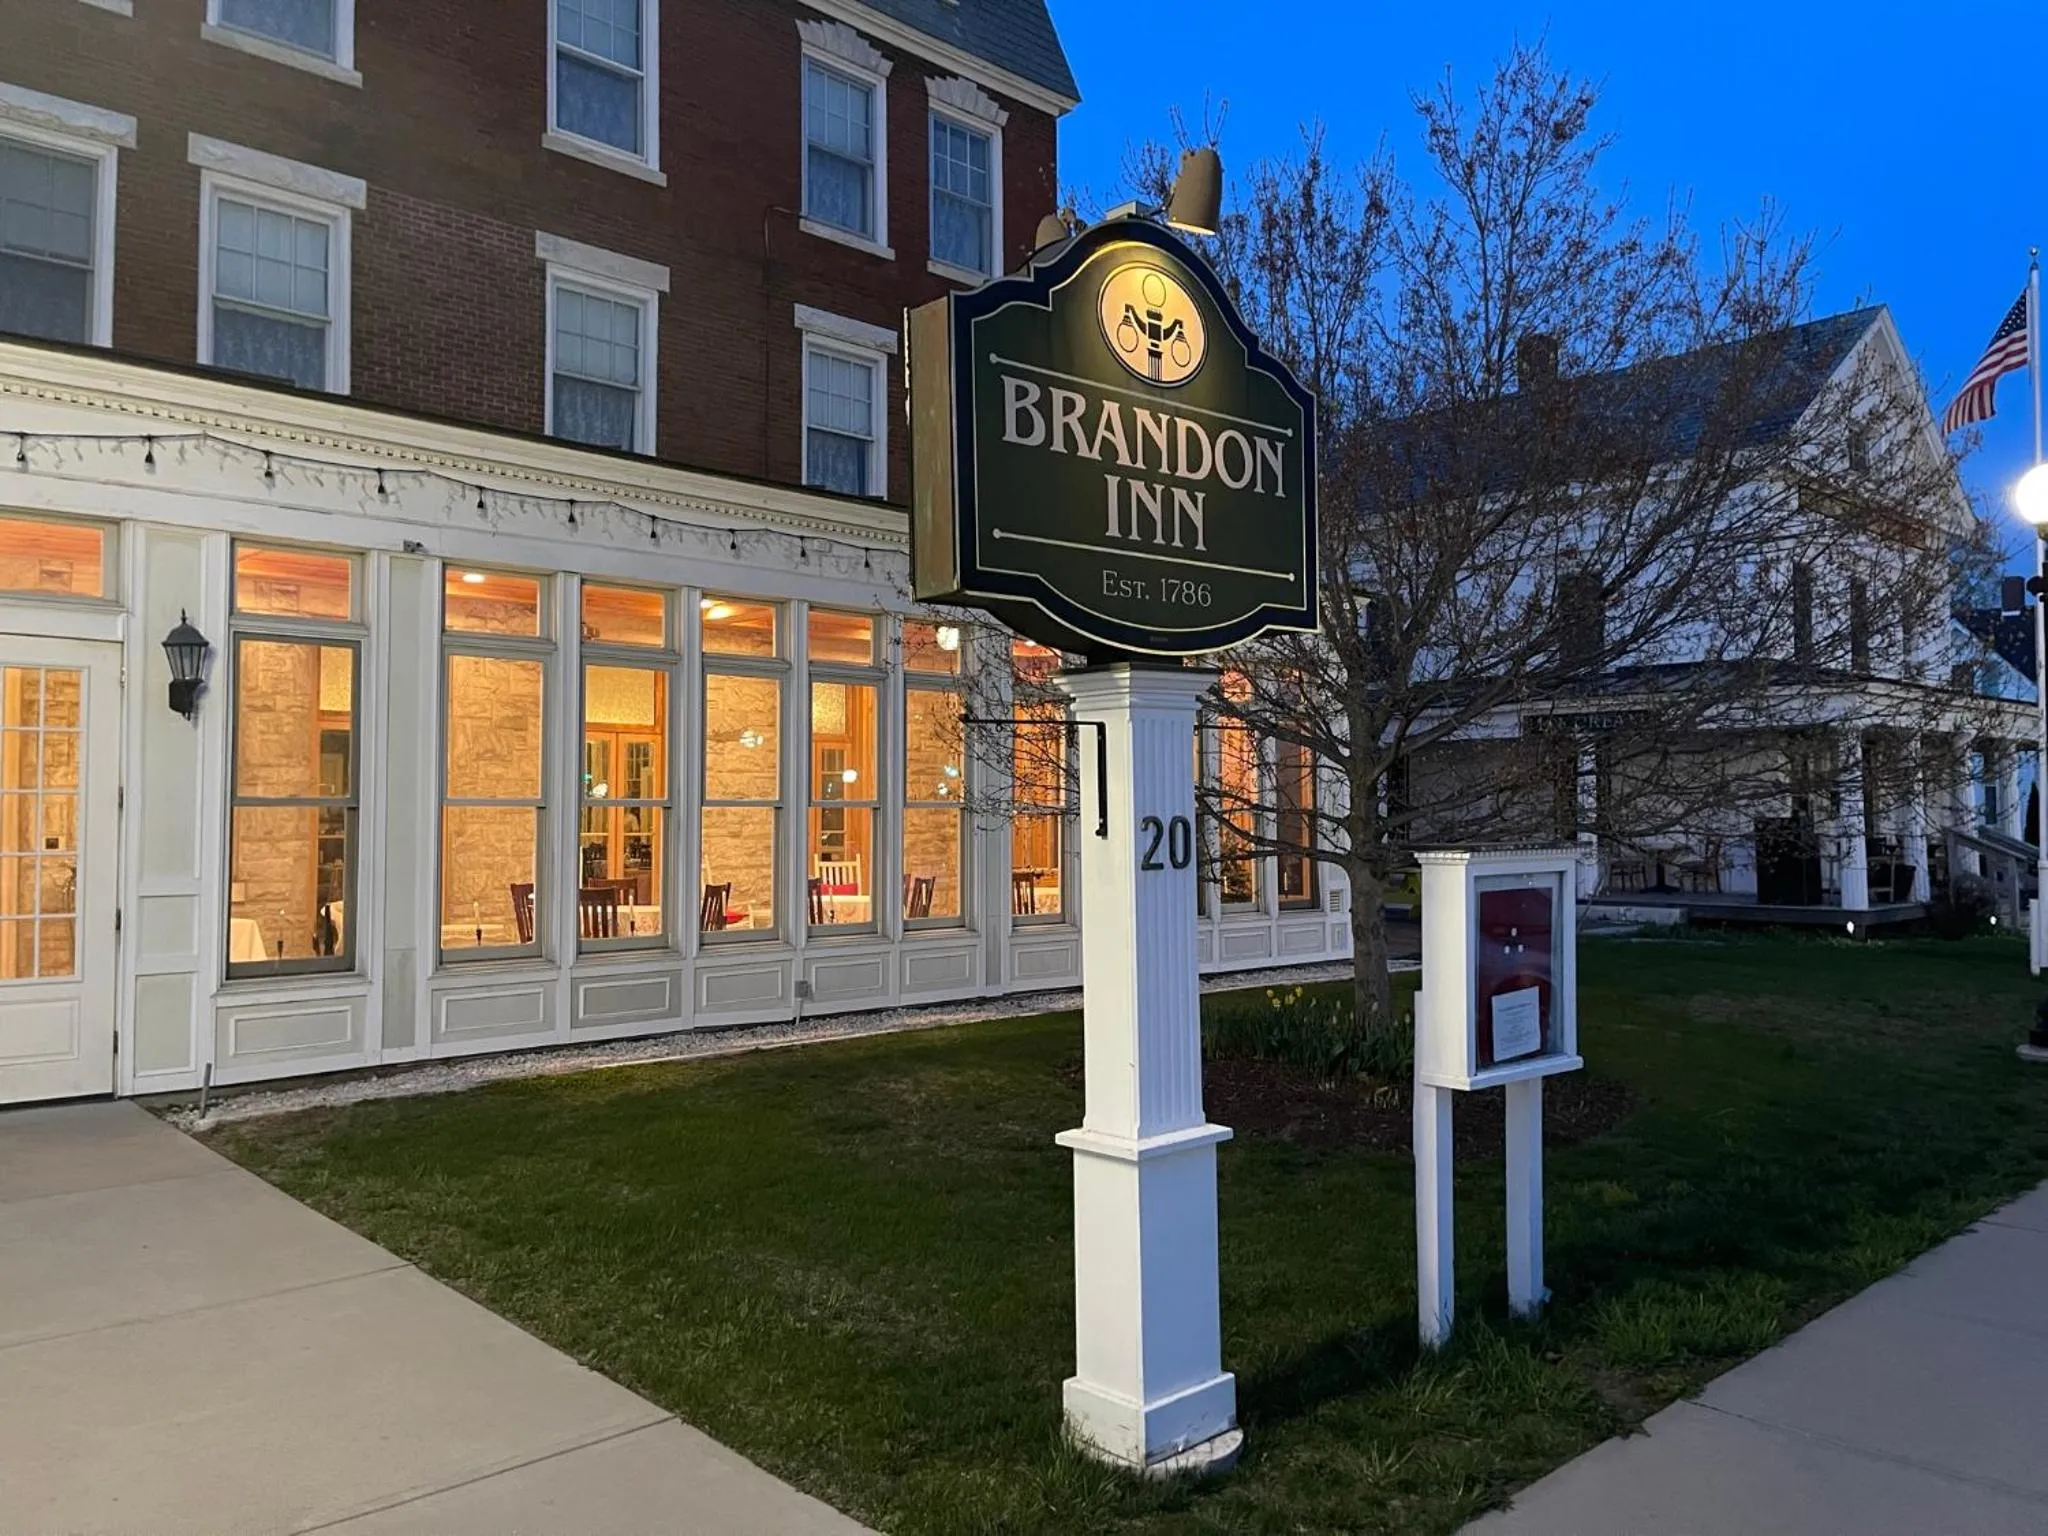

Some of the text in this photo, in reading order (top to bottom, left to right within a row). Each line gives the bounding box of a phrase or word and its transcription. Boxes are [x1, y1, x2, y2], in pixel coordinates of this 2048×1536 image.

[1001, 375, 1286, 498] BRANDON
[1104, 474, 1206, 551] INN
[1160, 578, 1212, 607] 1786
[1141, 815, 1192, 870] 20
